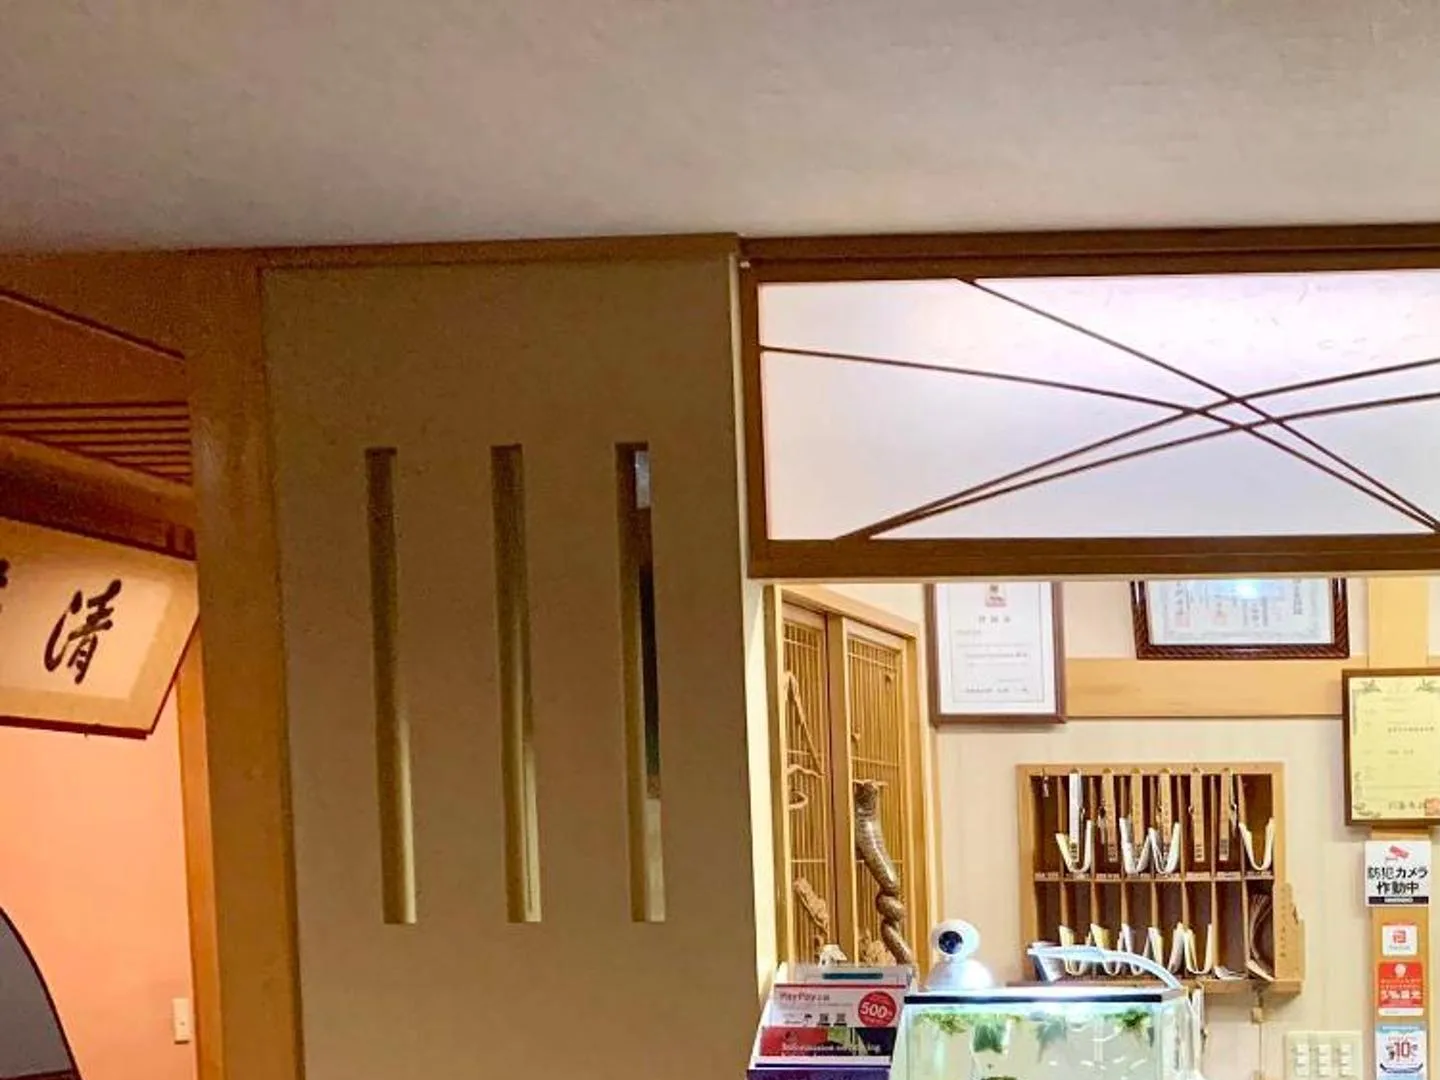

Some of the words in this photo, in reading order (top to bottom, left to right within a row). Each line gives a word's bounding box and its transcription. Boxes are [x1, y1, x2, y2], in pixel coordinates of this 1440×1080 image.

[1368, 866, 1429, 880] 防犯カメラ
[1377, 881, 1420, 895] 作動中
